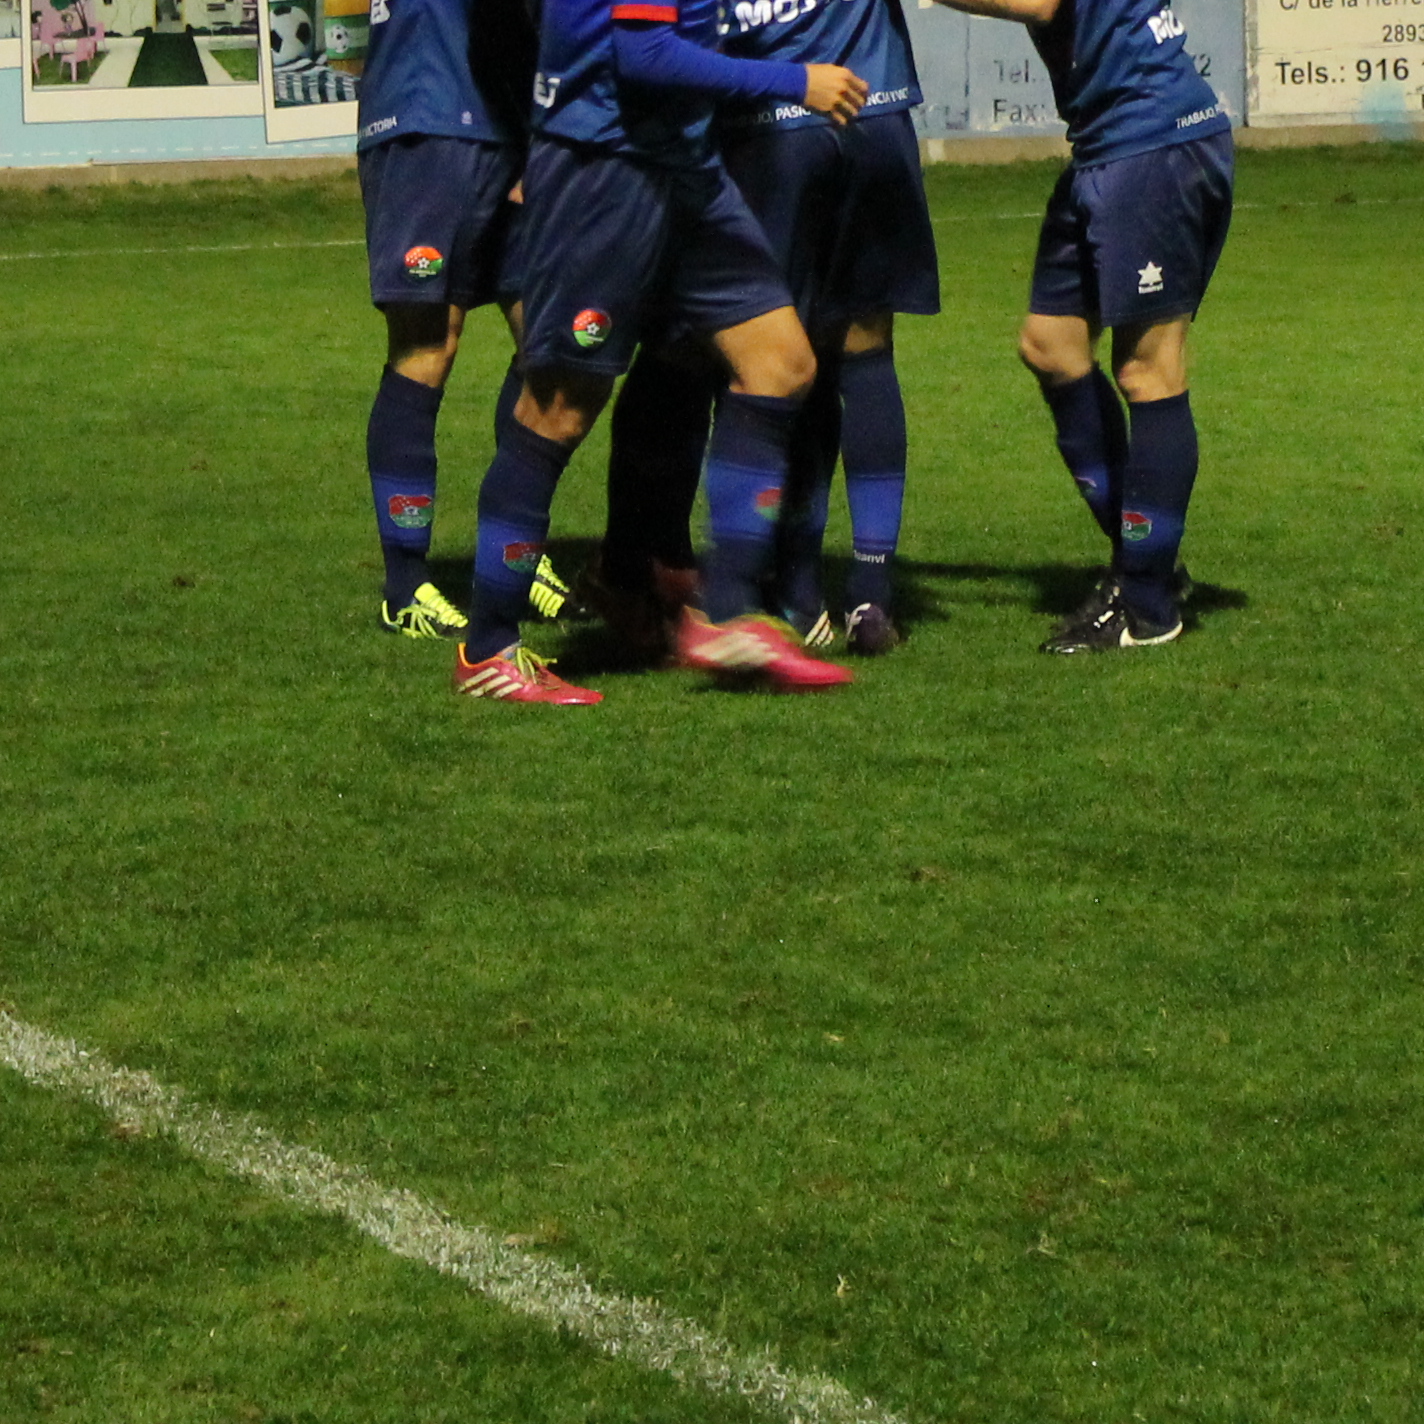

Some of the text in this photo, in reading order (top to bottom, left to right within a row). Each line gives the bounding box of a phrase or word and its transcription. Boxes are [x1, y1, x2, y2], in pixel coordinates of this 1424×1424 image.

[1275, 60, 1346, 85] Tels.:
[1355, 57, 1410, 83] 916
[993, 97, 1046, 123] Fax:
